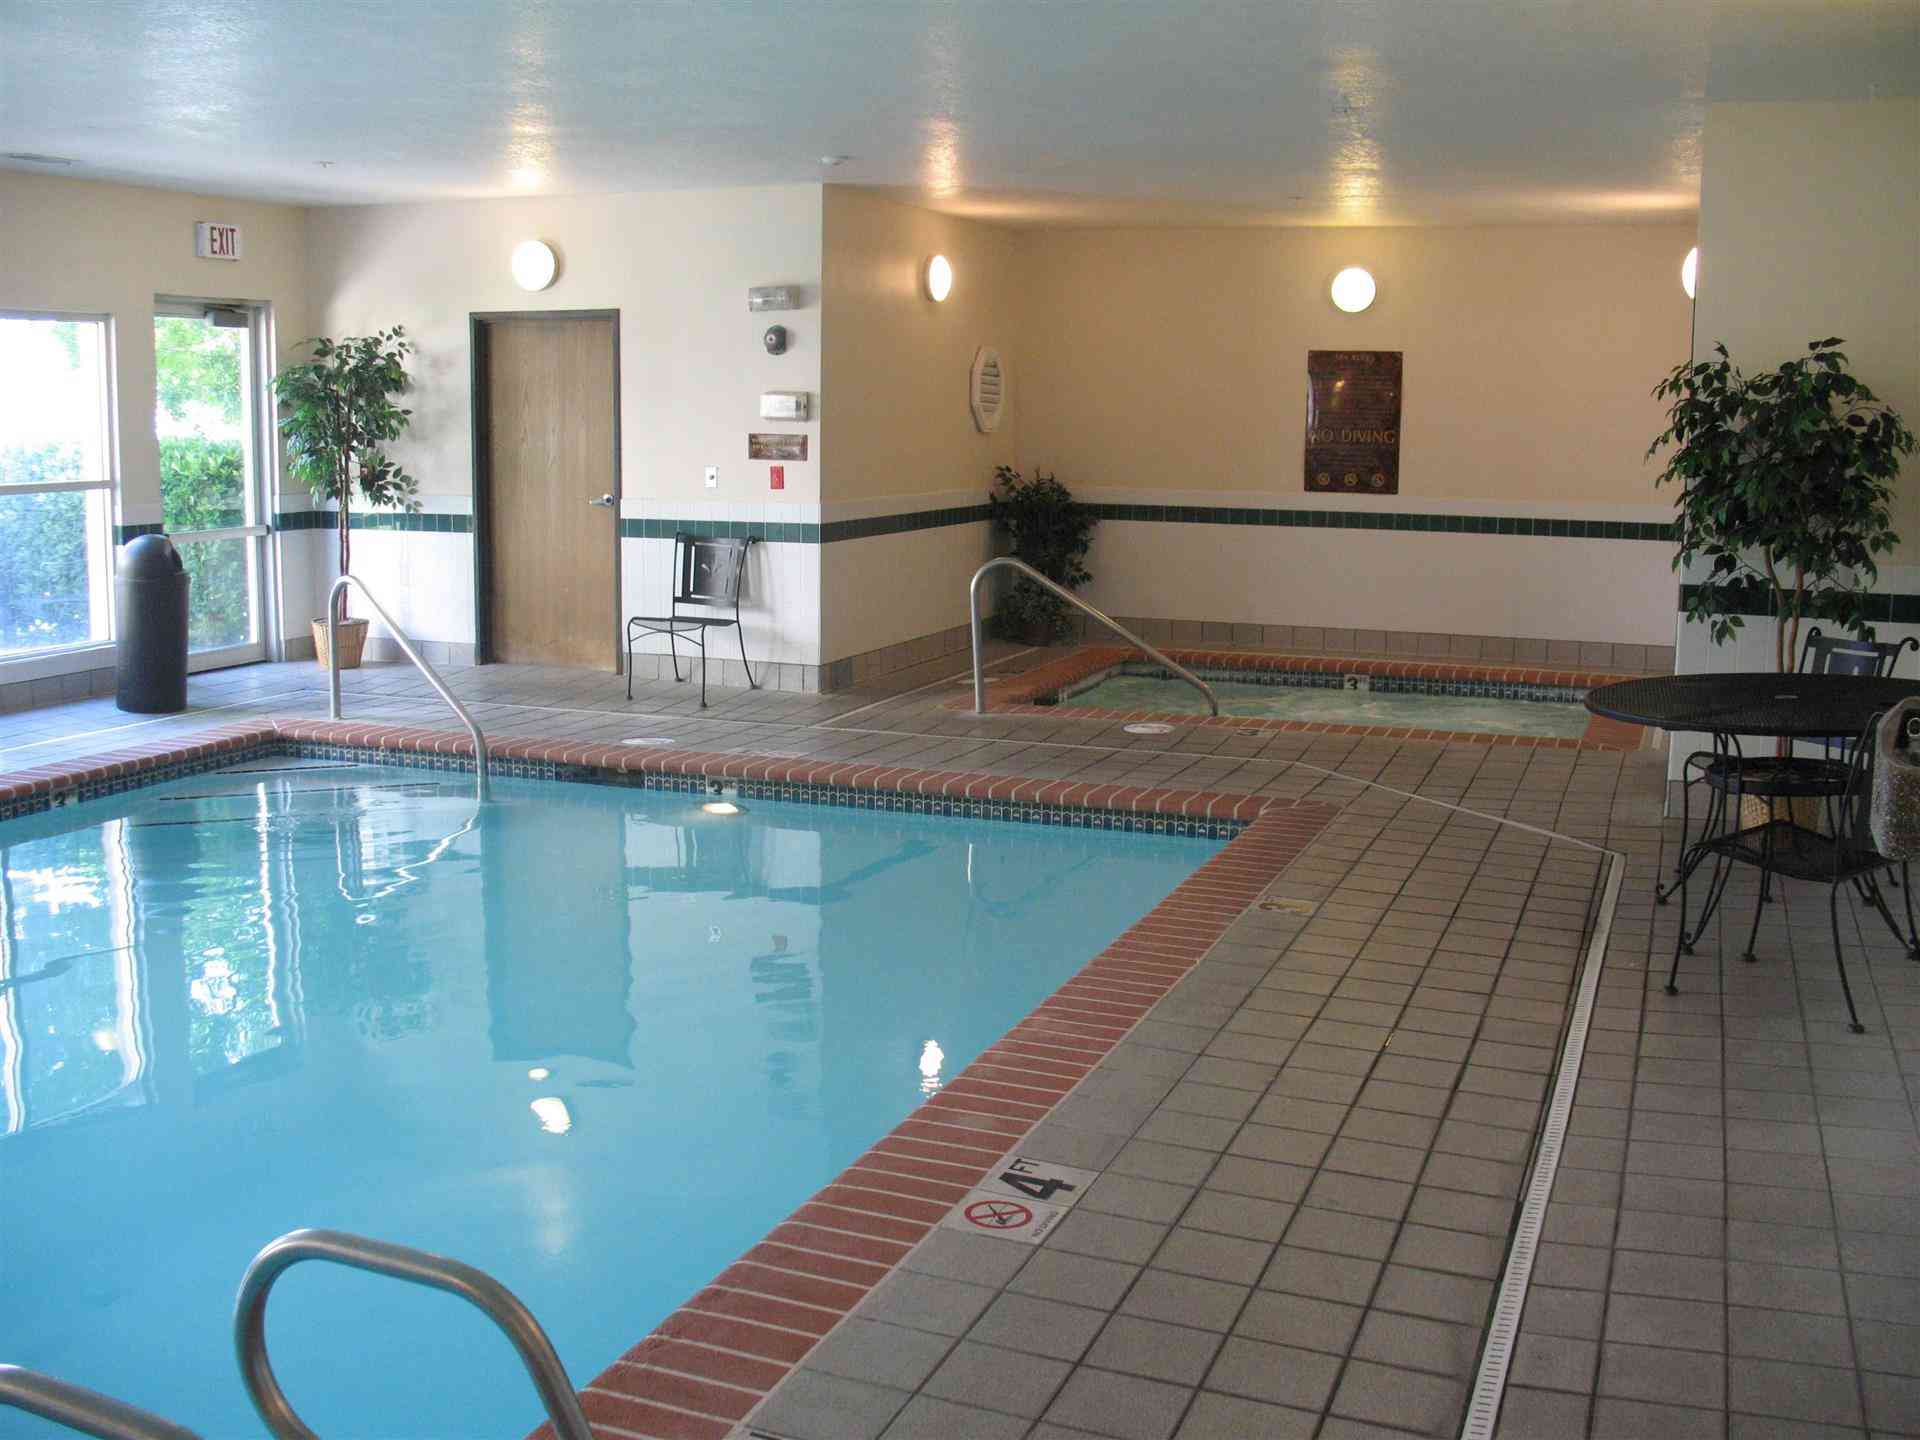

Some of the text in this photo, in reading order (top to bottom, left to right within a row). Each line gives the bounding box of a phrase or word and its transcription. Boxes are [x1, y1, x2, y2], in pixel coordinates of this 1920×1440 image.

[210, 226, 236, 256] EXIT
[1310, 429, 1395, 444] NO DIVING
[1346, 676, 1358, 690] 3
[1000, 1158, 1077, 1200] 4 FT
